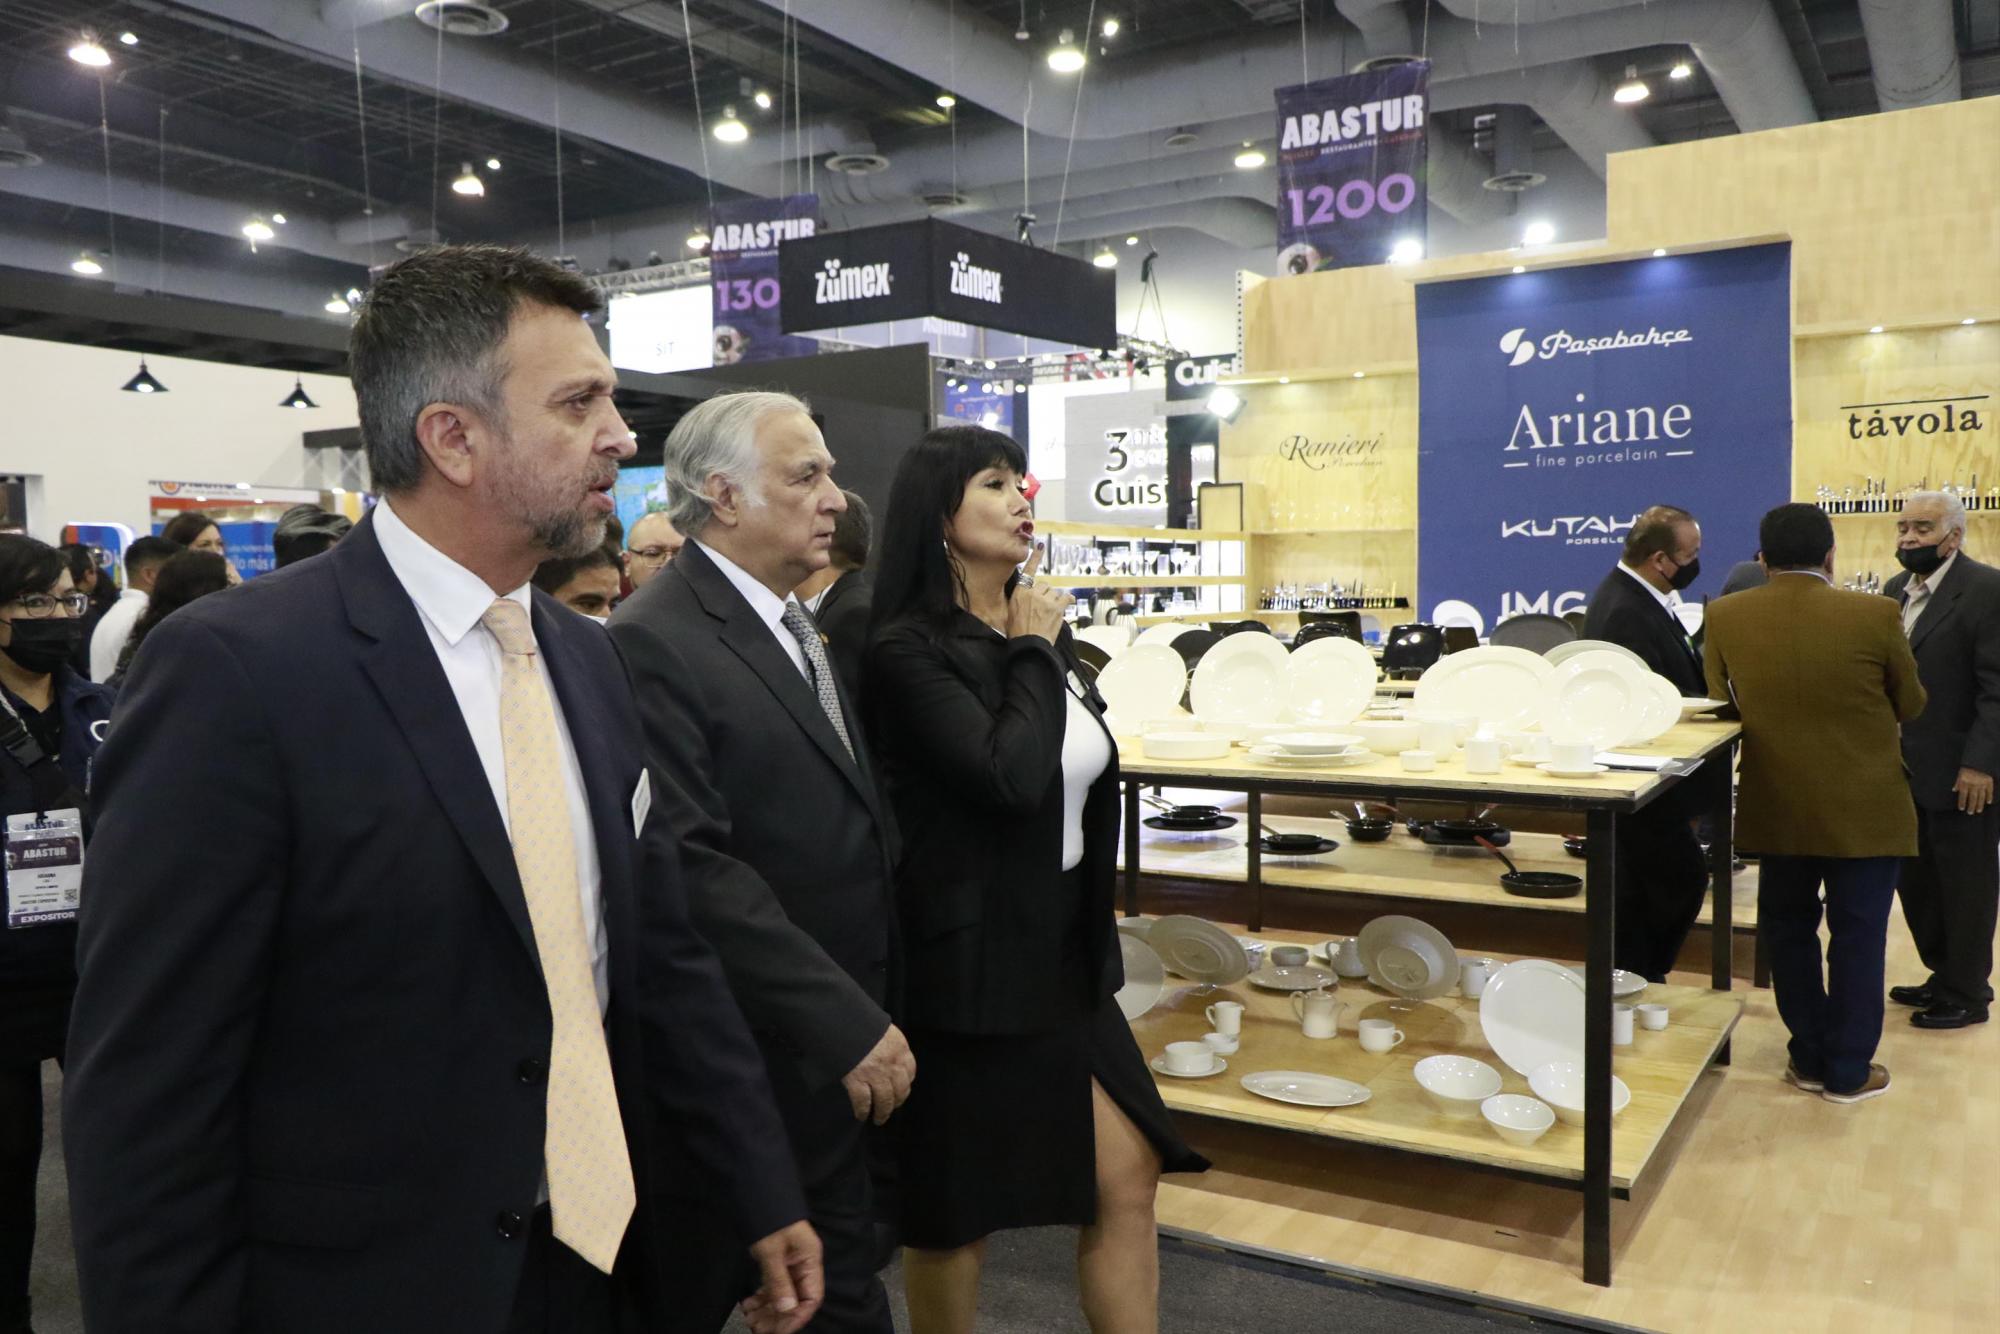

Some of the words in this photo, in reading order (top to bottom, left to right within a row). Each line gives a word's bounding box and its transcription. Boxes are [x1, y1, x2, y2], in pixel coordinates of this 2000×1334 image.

[1281, 94, 1424, 150] ABASTUR
[1287, 173, 1416, 227] 1200
[716, 277, 781, 312] 130
[1503, 392, 1692, 451] Ariane
[1105, 431, 1128, 472] 3
[1279, 432, 1384, 471] Ranieri
[1535, 454, 1567, 468] fine
[1575, 447, 1658, 468] porcelain
[1502, 514, 1642, 538] KUTAH
[22, 911, 75, 923] EXPOSITOR
